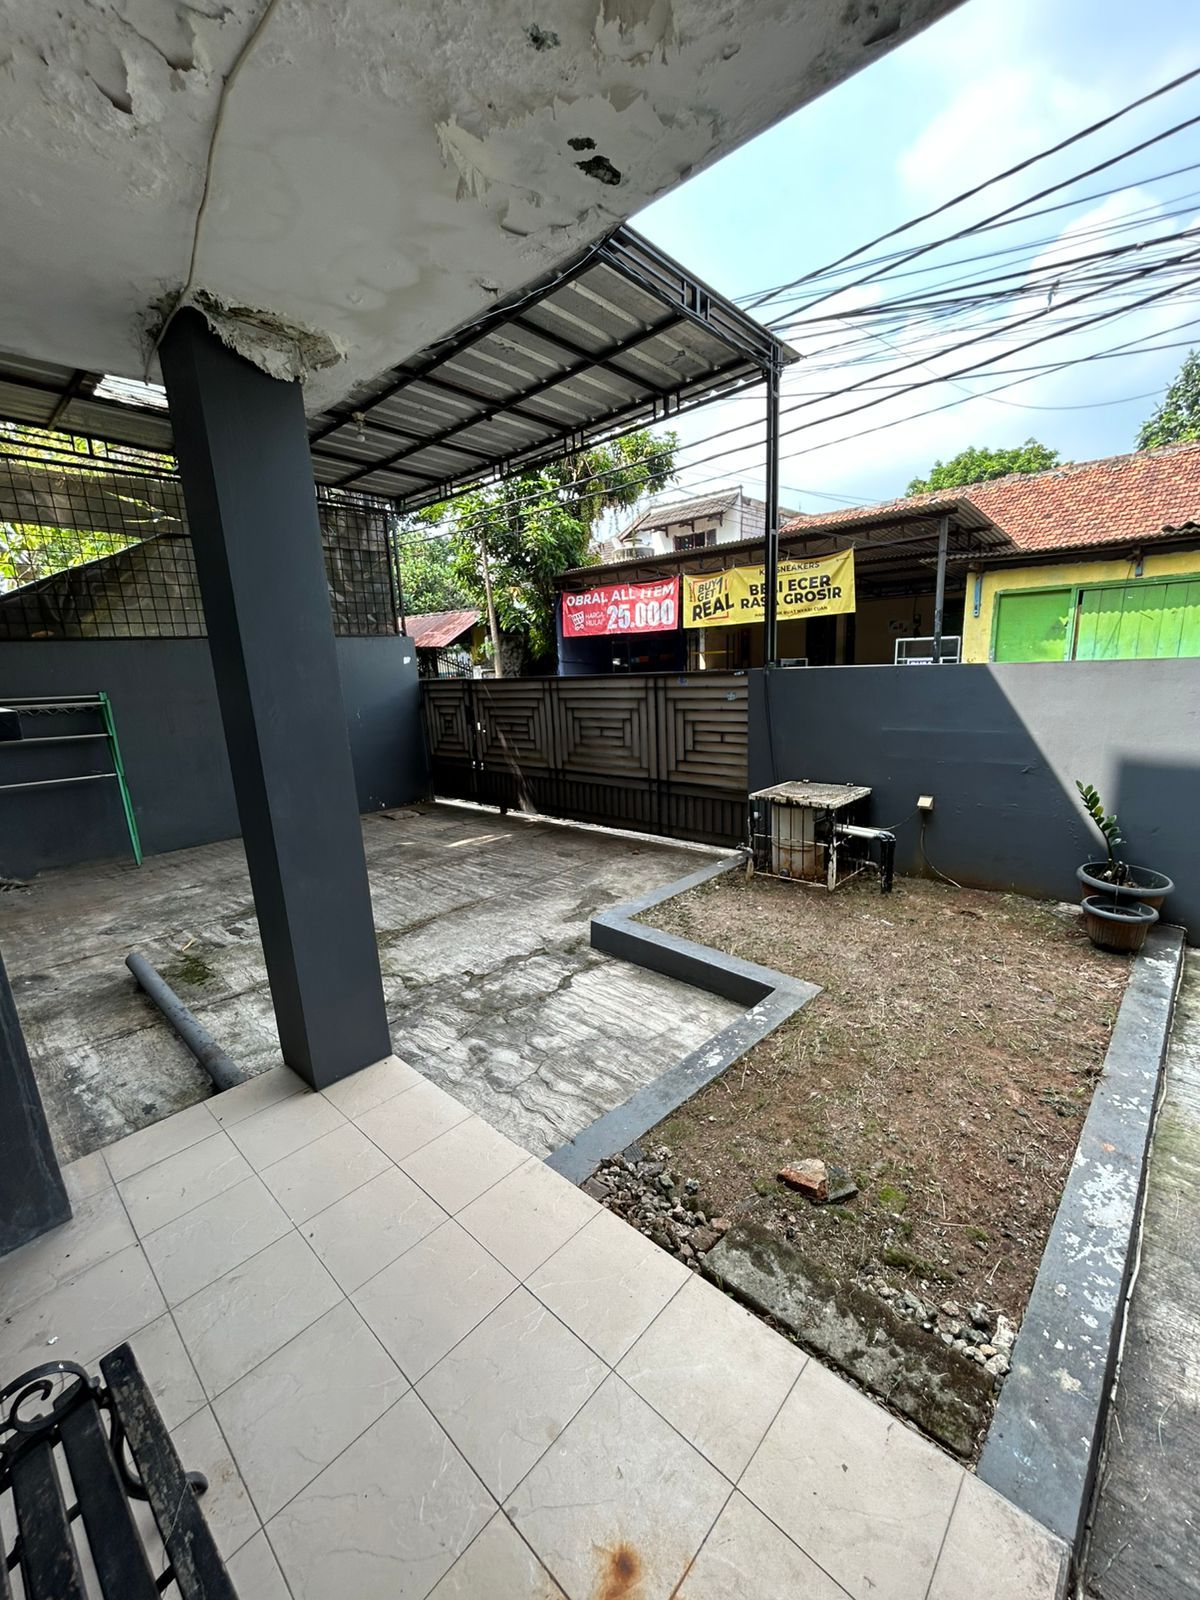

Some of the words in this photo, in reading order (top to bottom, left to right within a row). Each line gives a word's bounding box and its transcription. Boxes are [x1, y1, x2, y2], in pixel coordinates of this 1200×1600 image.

[566, 592, 608, 606] OBRAL
[611, 588, 636, 602] ALL
[639, 582, 675, 599] ITEM
[697, 588, 716, 602] GET
[698, 579, 717, 593] BUY
[749, 580, 783, 596] BEI
[788, 574, 831, 592] ECER
[692, 592, 734, 621] REAL
[741, 594, 780, 609] RAS
[783, 586, 842, 605] GROSIR
[607, 598, 674, 630] 25.000
